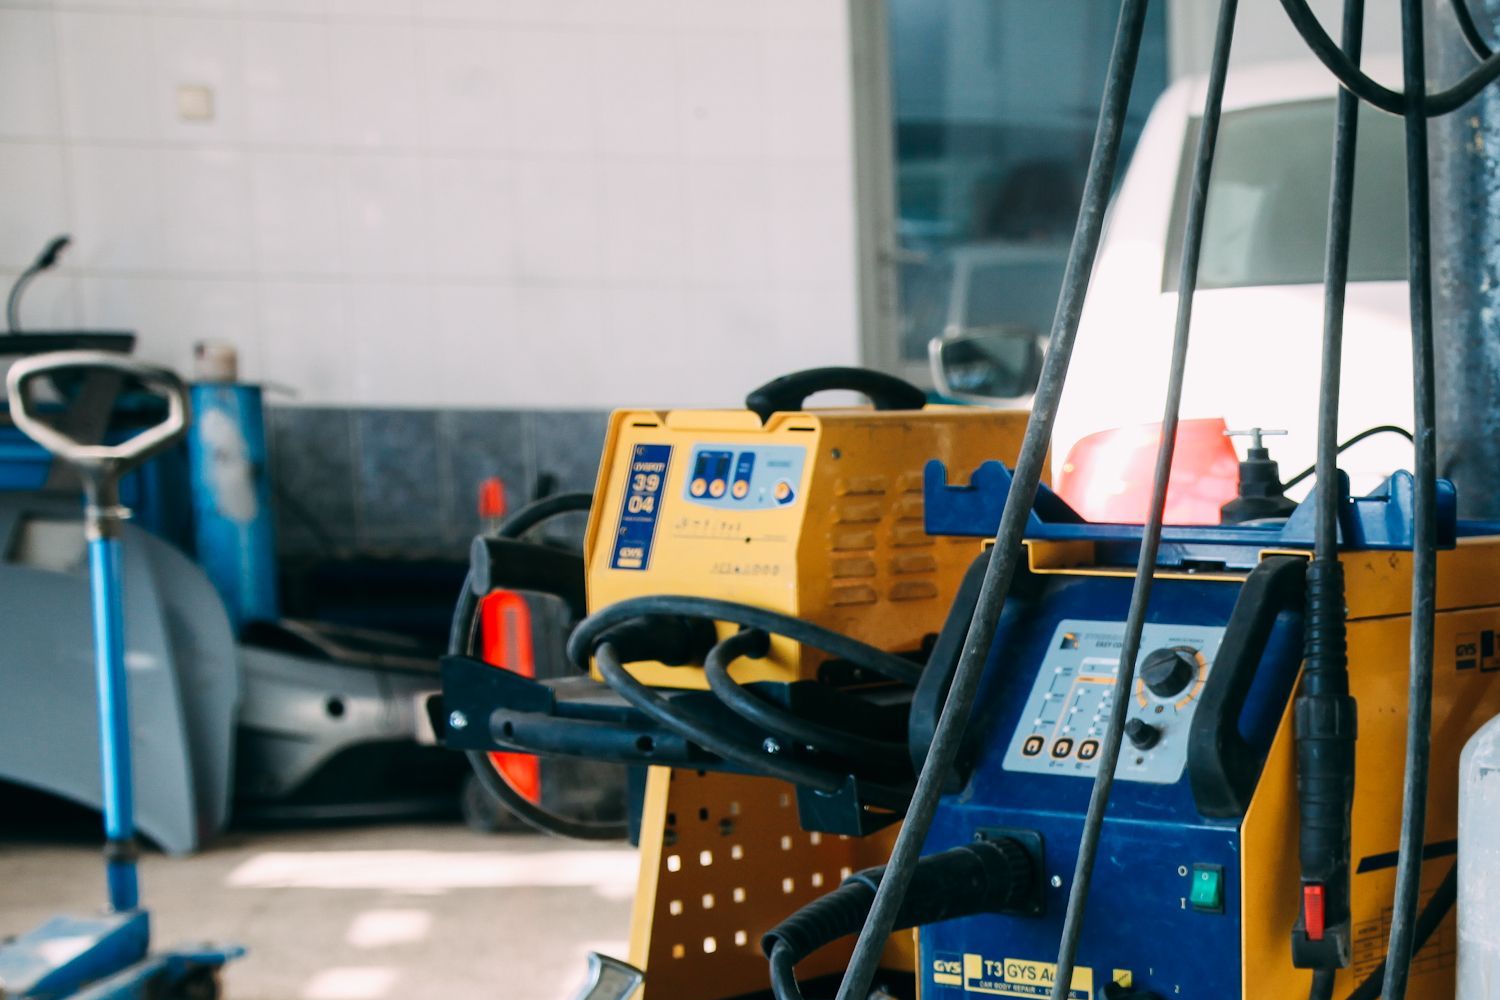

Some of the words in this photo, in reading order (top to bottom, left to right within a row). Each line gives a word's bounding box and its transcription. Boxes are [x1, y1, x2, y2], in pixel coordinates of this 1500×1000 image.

[632, 473, 661, 493] 39
[627, 495, 655, 514] 04
[933, 959, 962, 974] GYS
[984, 960, 1003, 977] T3
[1007, 963, 1037, 980] GYS
